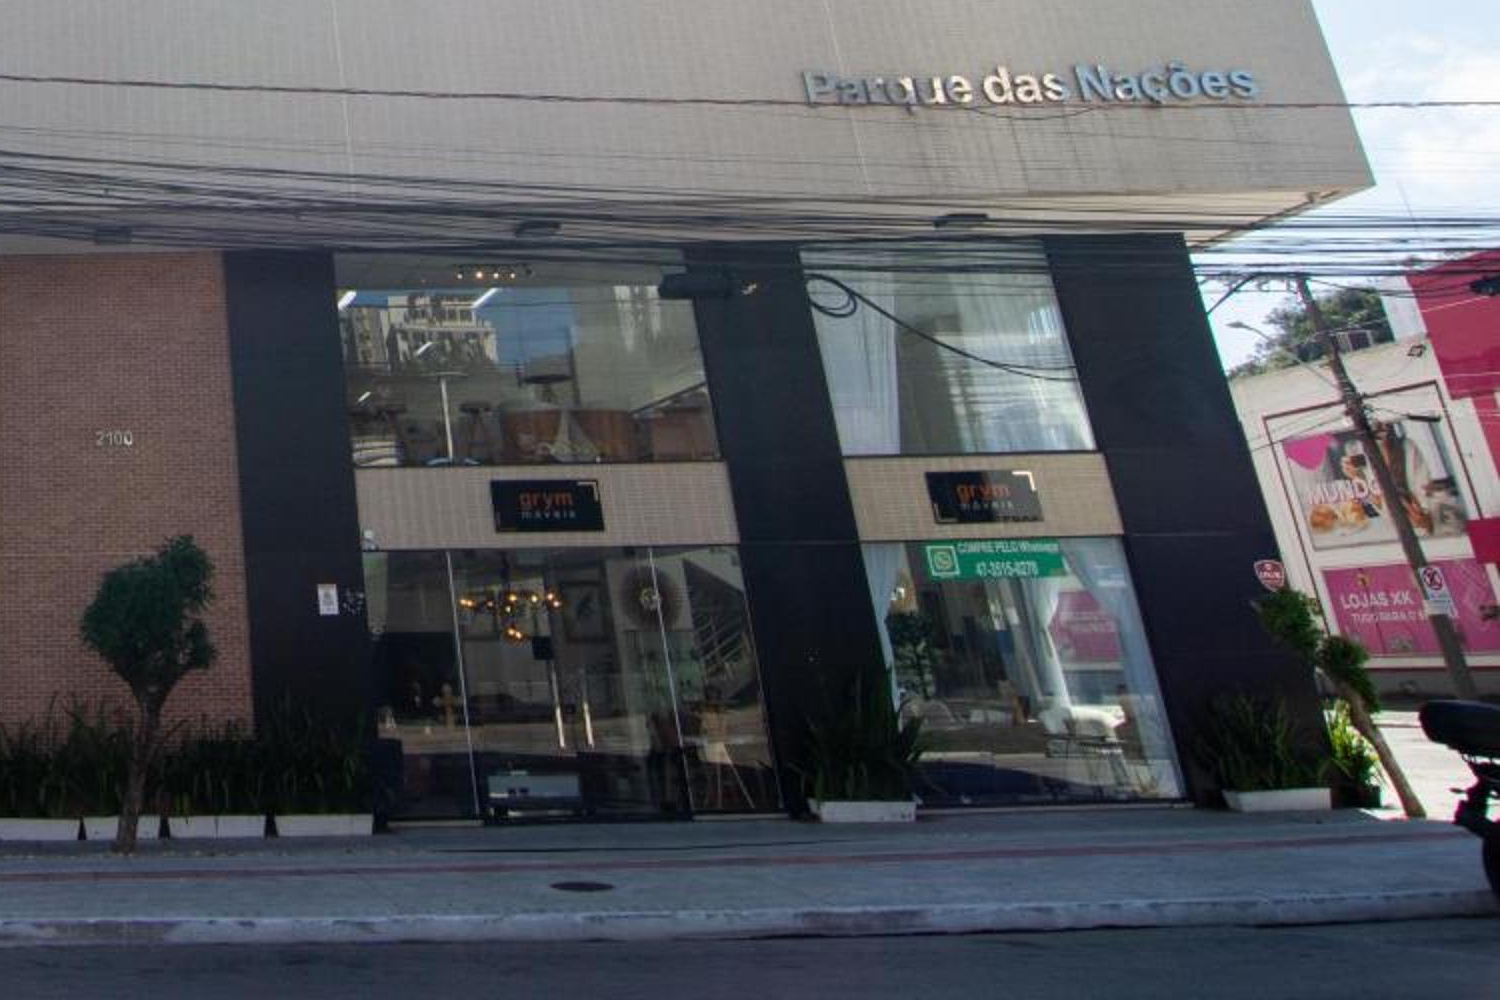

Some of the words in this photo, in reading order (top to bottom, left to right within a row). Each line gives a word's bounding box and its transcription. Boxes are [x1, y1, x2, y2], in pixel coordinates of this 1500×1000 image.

[803, 71, 973, 116] Parque
[983, 65, 1068, 105] das
[1074, 59, 1261, 106] Nações
[95, 430, 133, 447] 2100
[1340, 591, 1389, 610] LOJAS
